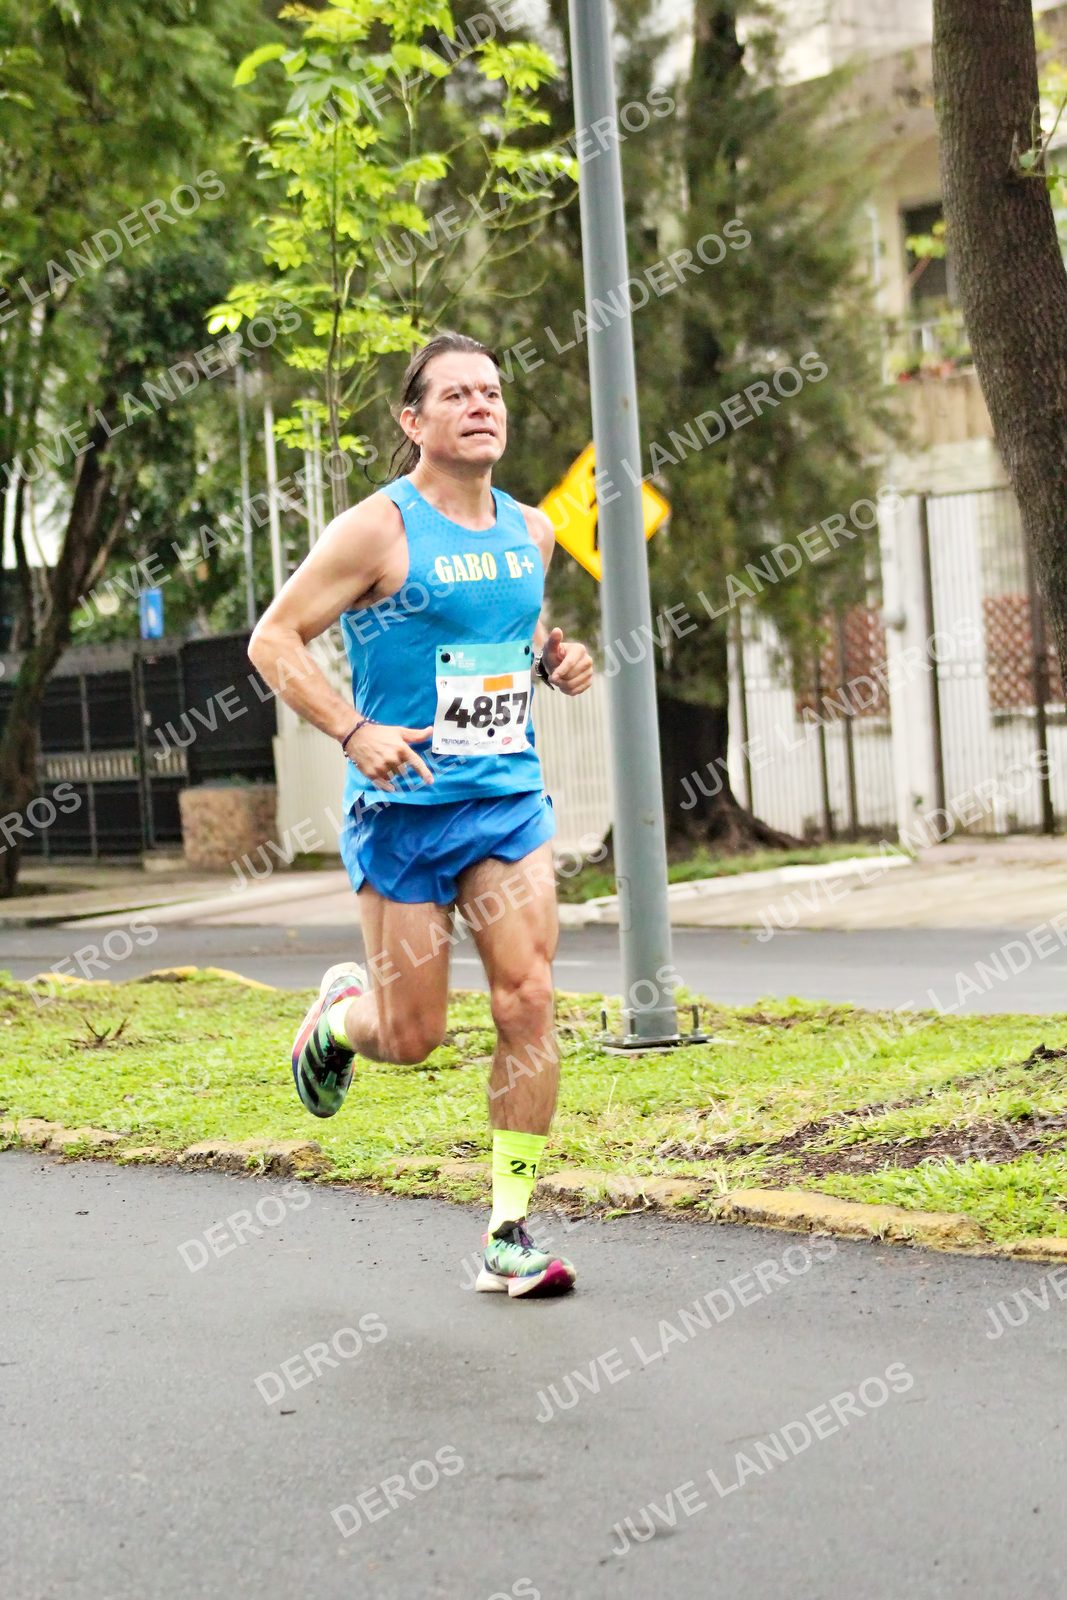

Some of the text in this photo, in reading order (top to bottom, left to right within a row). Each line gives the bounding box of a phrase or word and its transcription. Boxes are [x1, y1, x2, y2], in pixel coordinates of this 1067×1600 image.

[434, 550, 535, 584] GABO B+
[443, 691, 528, 729] 4857
[509, 1159, 537, 1178] 21
